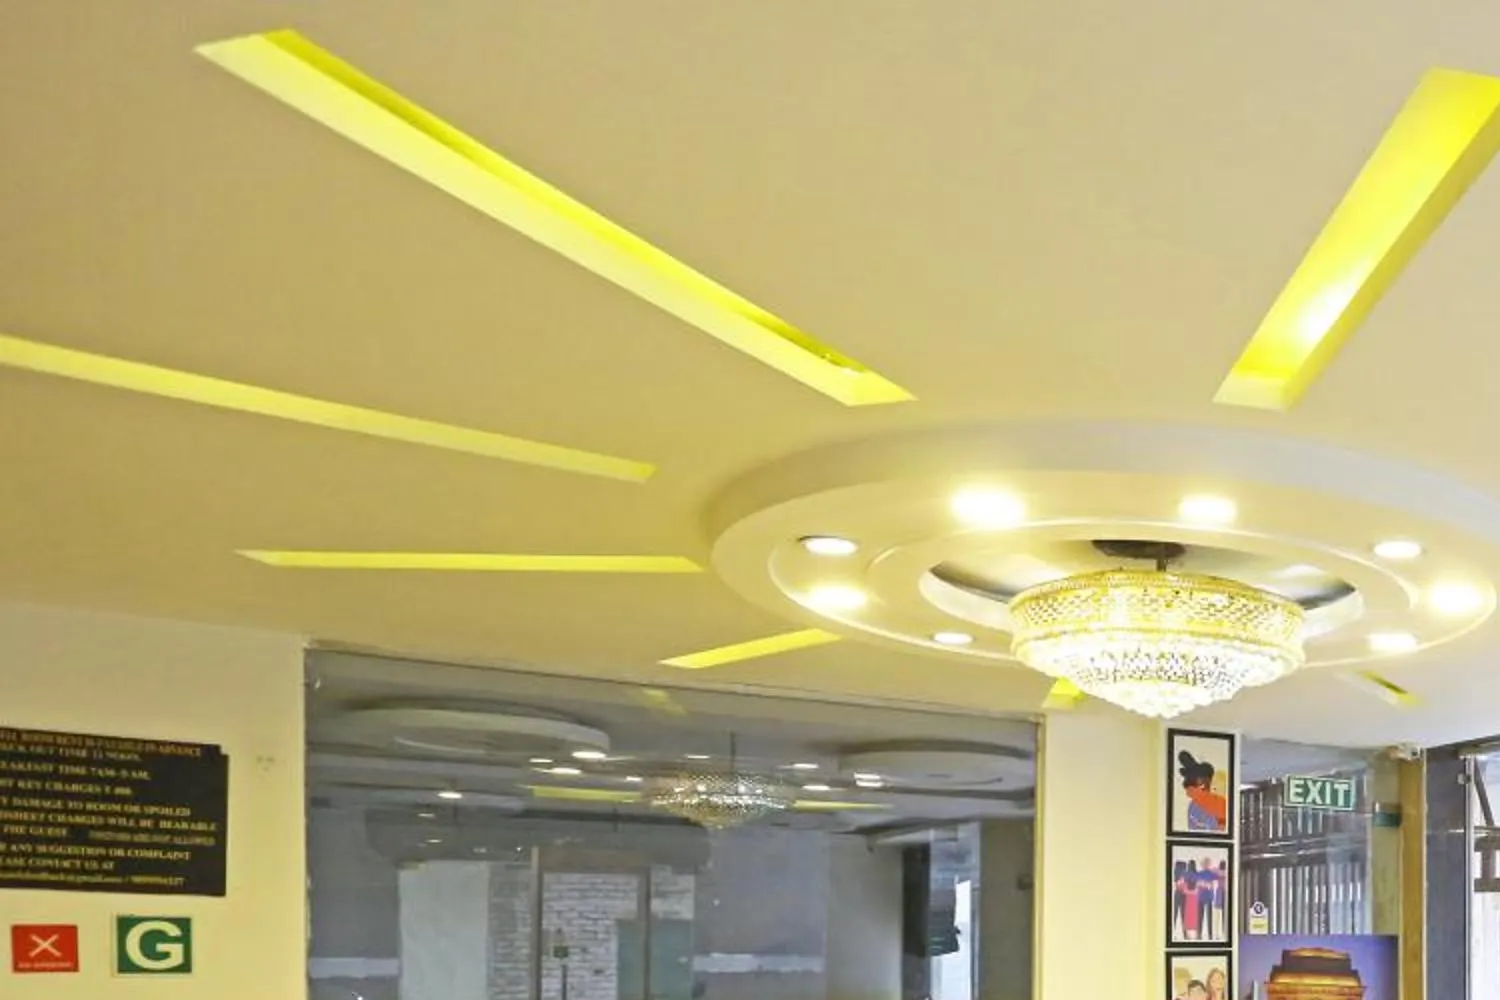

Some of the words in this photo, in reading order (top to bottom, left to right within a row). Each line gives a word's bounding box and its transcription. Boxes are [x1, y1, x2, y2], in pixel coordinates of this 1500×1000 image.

[59, 747, 87, 757] TIME
[59, 764, 87, 775] TIME
[17, 779, 42, 790] KEY
[44, 781, 102, 793] CHARGES
[1289, 779, 1350, 806] EXIT
[12, 796, 64, 809] DAMAGE
[67, 800, 84, 811] TO
[86, 801, 121, 812] ROOM
[123, 803, 141, 814] OR
[143, 805, 191, 816] SPOILED
[48, 813, 105, 824] CHARGES
[107, 816, 136, 827] WILL
[138, 818, 155, 829] BE
[159, 819, 216, 830] BEARABLE
[3, 824, 27, 835] THE
[29, 826, 67, 837] GUEST
[10, 843, 33, 854] ANY
[35, 844, 106, 856] SUGGESTION
[109, 848, 125, 858] OR
[127, 848, 192, 860] COMPLAINT
[28, 857, 81, 868] CONTACT
[101, 861, 115, 871] AT
[126, 920, 185, 970] G
